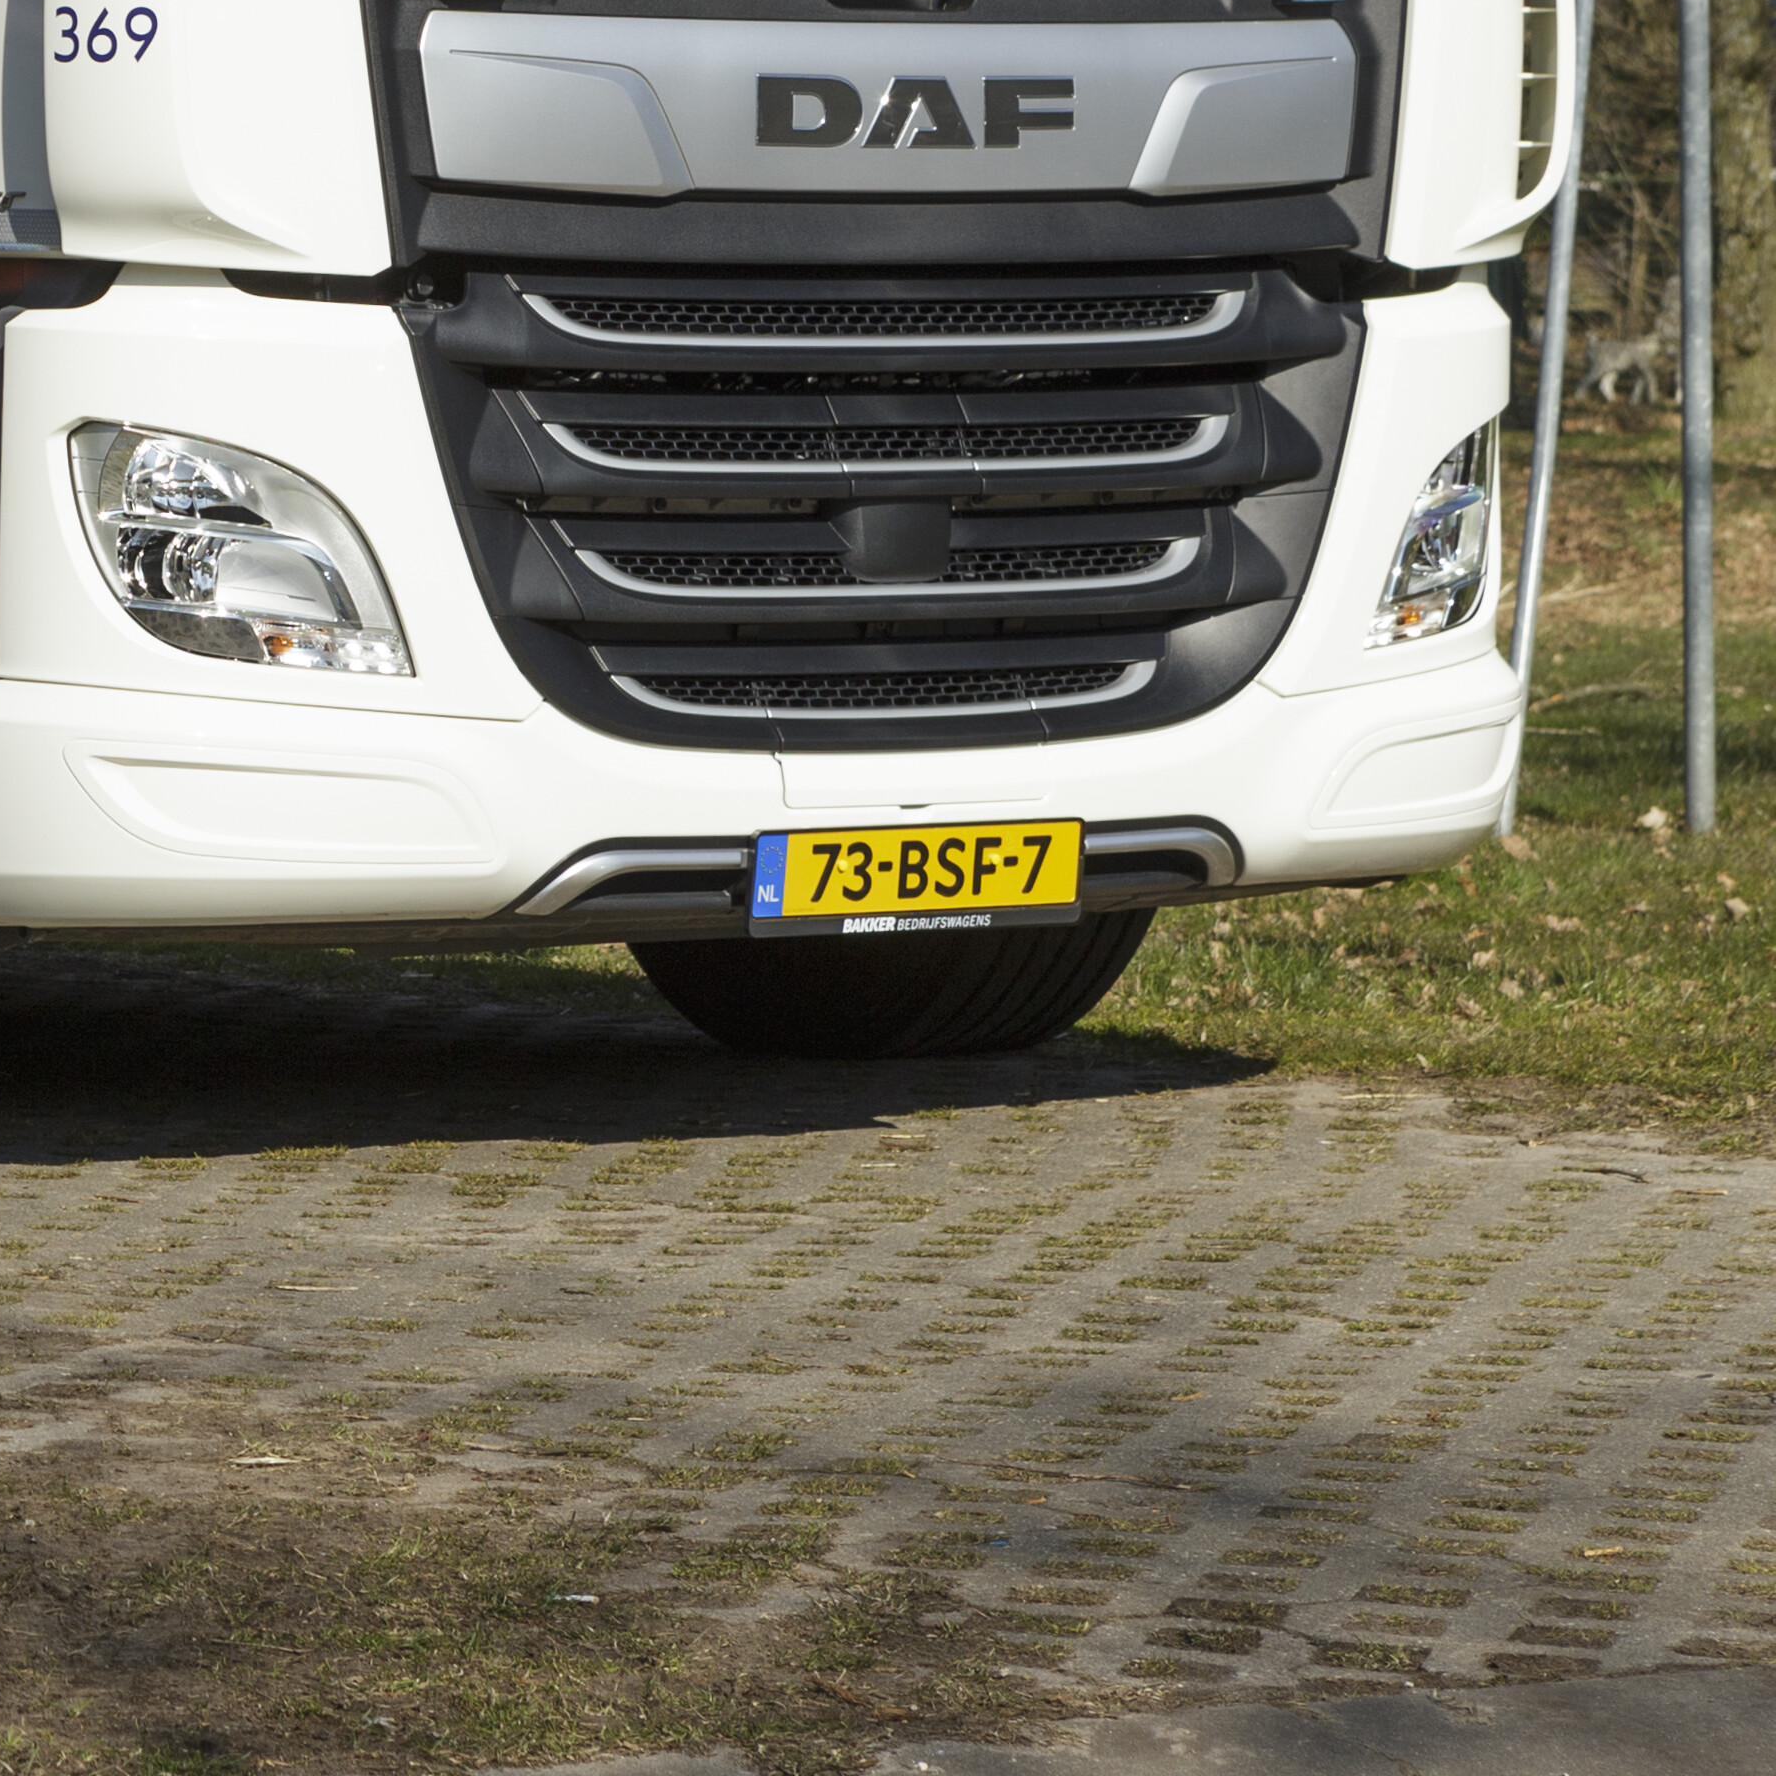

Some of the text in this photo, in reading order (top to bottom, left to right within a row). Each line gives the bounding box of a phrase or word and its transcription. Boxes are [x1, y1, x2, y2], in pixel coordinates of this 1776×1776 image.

[53, 6, 158, 63] 369
[755, 73, 1076, 150] DAF
[757, 884, 779, 903] NL
[810, 834, 1052, 903] 73-BSF-7
[842, 913, 991, 934] BAKKER BEDRIJFSWAGENS
